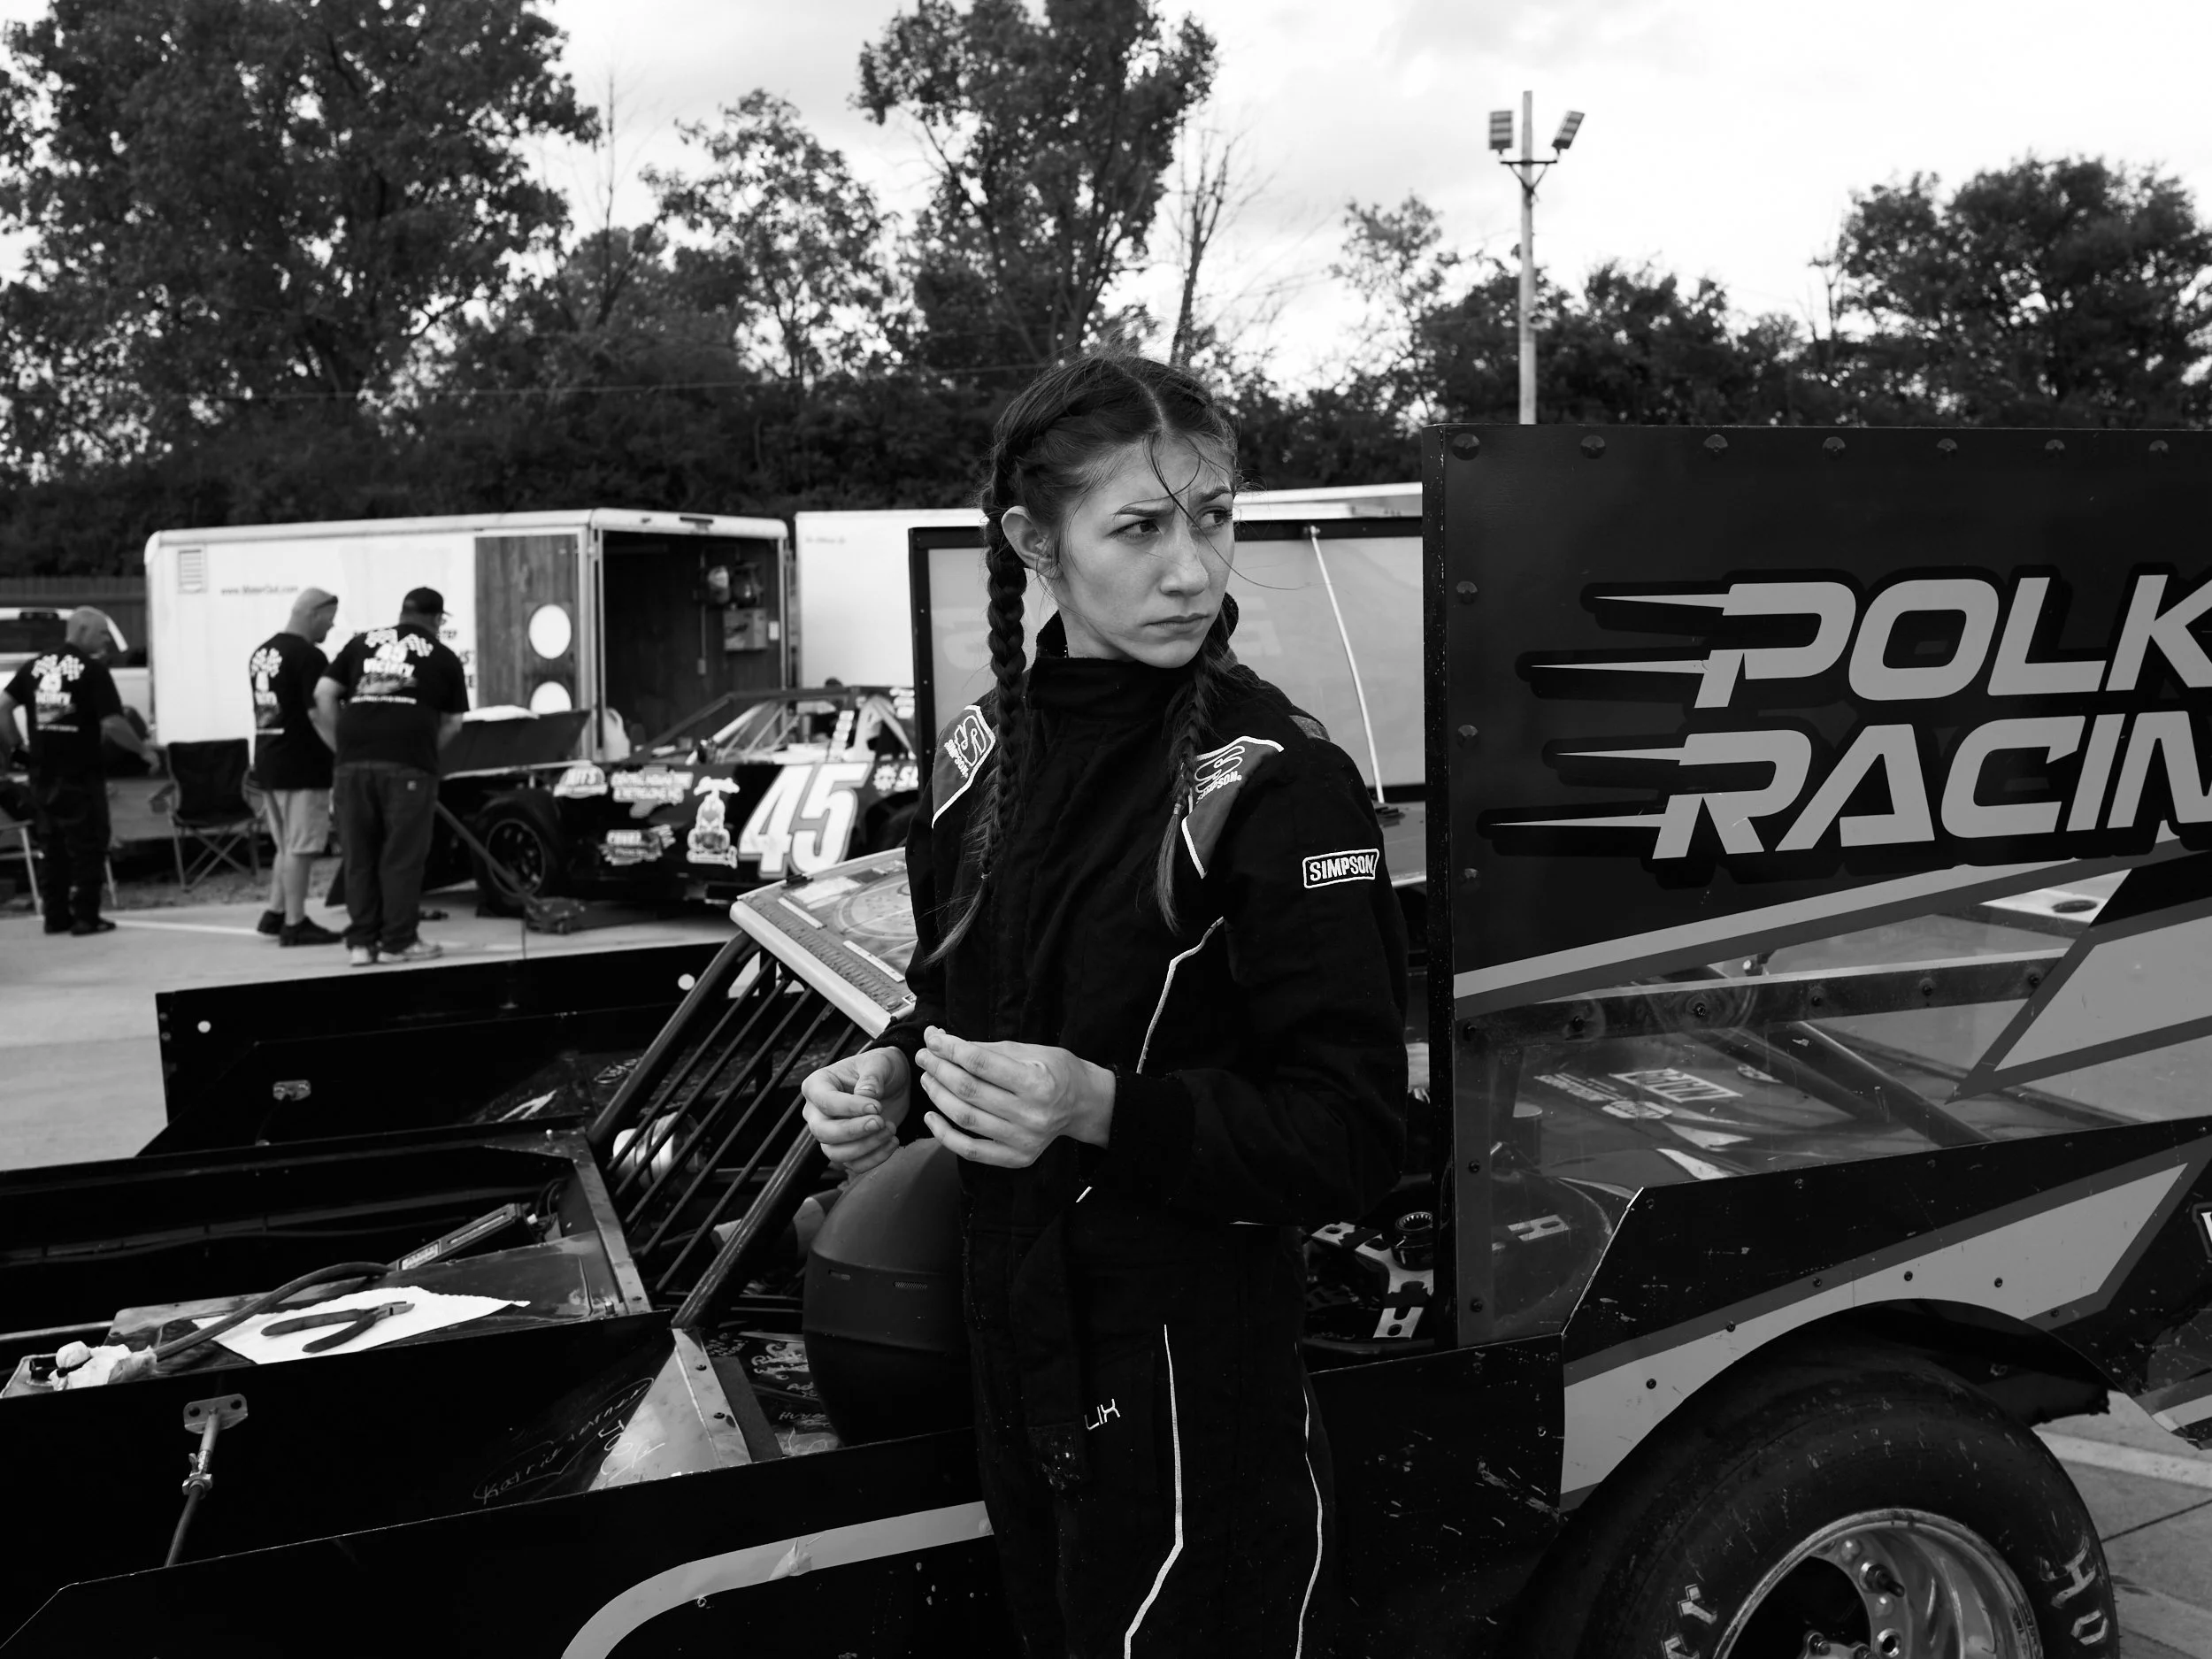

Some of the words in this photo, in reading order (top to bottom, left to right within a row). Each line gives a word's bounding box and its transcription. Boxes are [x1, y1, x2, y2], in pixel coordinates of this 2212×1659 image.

[1694, 573, 2212, 708] POLK
[738, 762, 872, 879] 45
[1652, 710, 2212, 859] RACIN
[1309, 855, 1375, 882] SIMPSON
